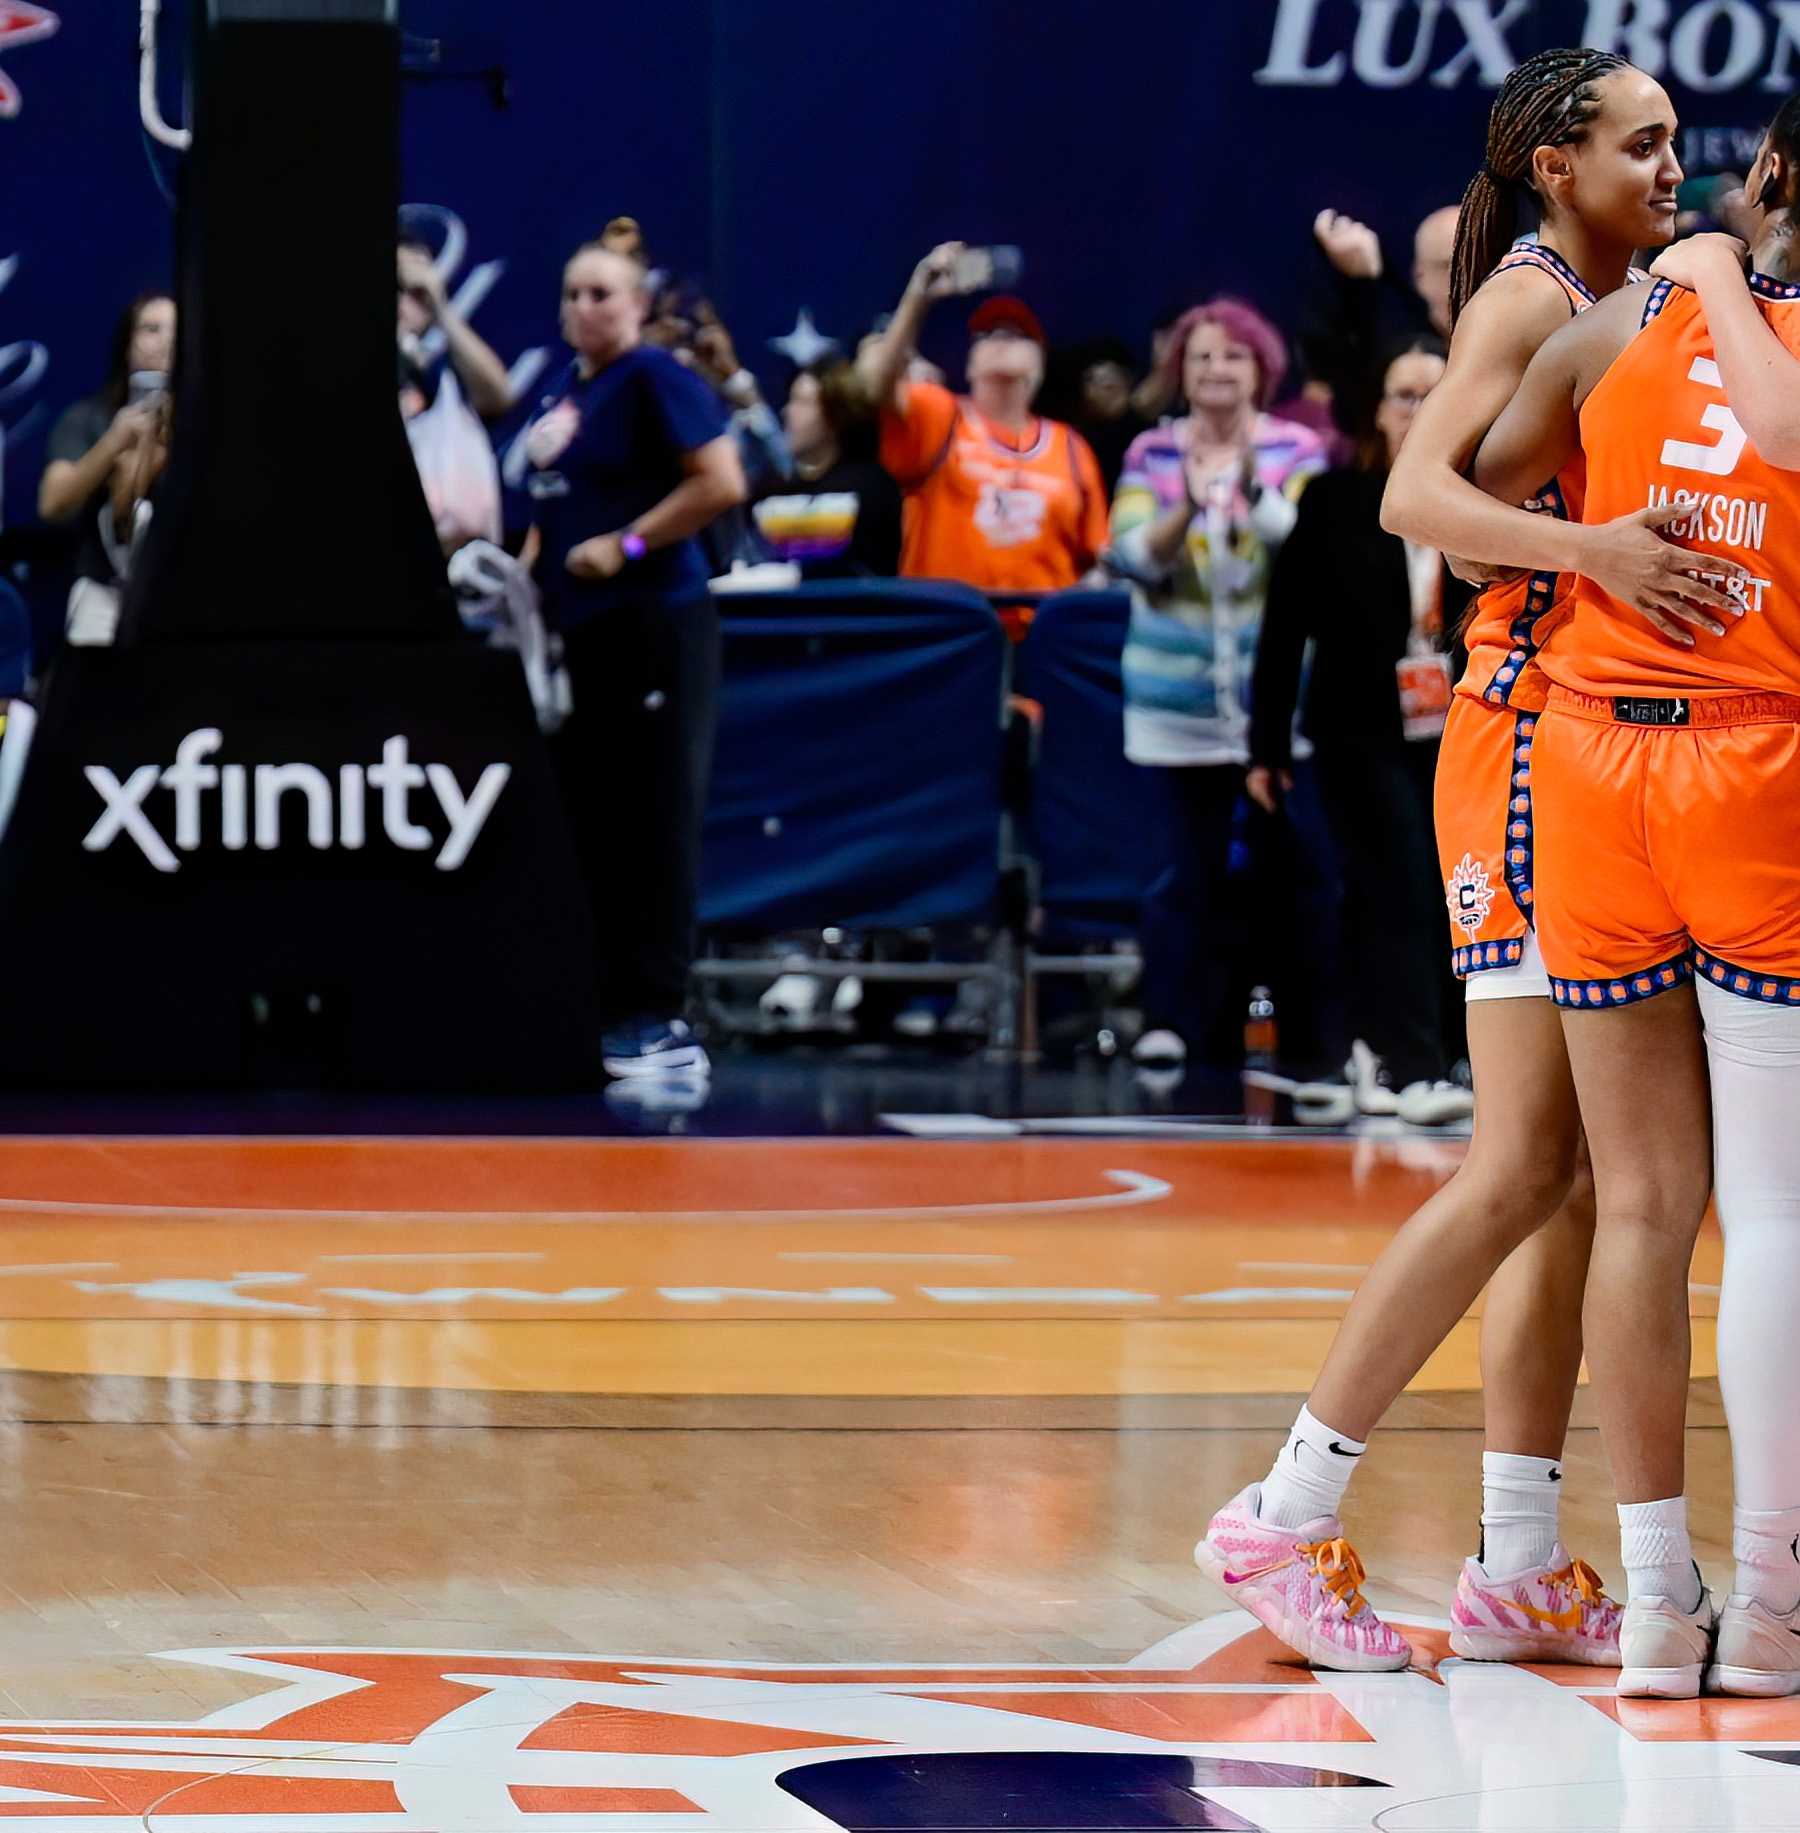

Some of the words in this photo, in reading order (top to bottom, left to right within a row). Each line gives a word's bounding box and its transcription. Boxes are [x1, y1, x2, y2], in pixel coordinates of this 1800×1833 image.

[1660, 355, 1748, 477] 3
[1687, 570, 1772, 612] T&T
[81, 727, 512, 874] xfinity
